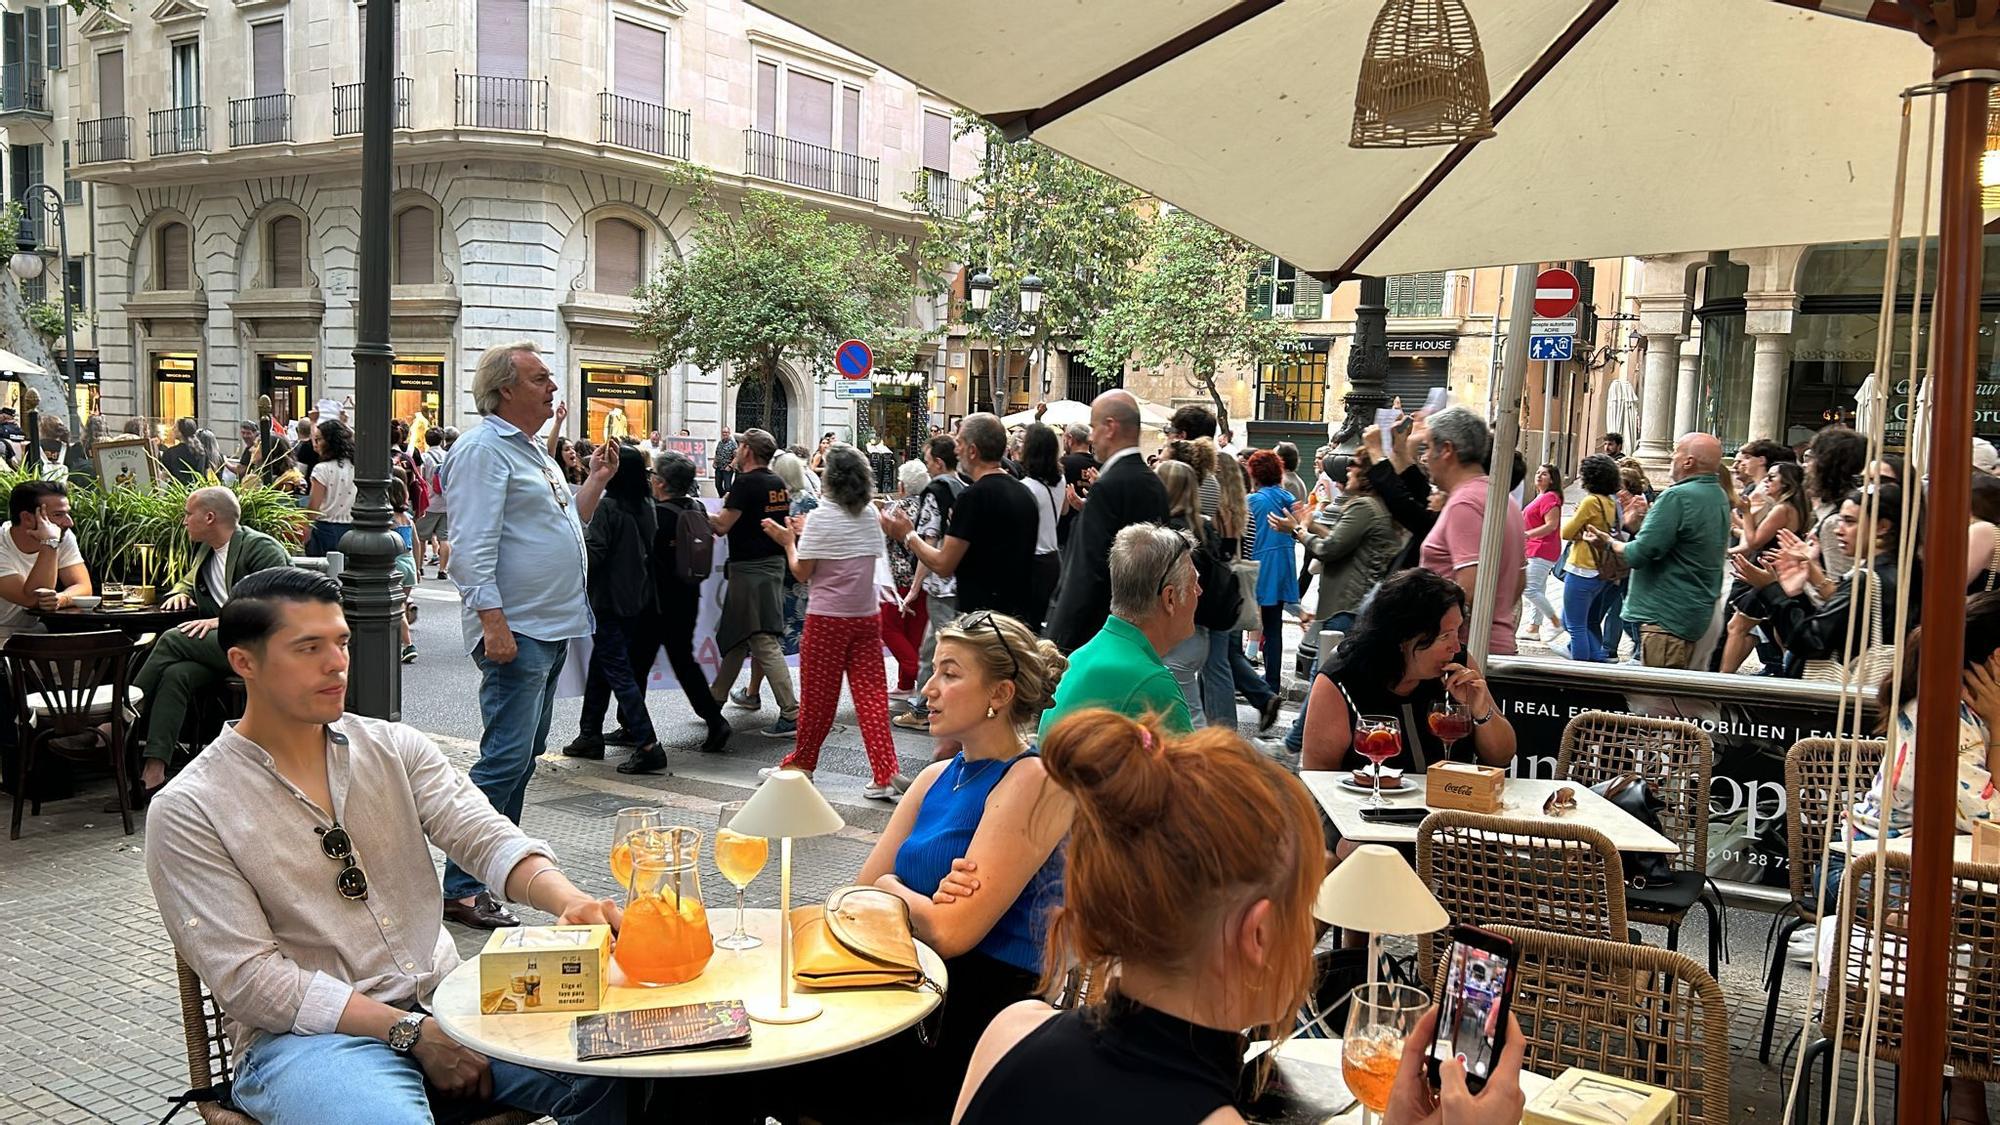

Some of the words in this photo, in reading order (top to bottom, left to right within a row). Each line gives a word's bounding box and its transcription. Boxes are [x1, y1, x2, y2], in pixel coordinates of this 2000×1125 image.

[1386, 341, 1413, 350] FFEE
[1415, 340, 1452, 350] HOUSE
[1514, 701, 1560, 718] REAL
[1658, 715, 1786, 740] OBILIEN
[1722, 849, 1740, 863] 01
[1748, 853, 1768, 867] 28
